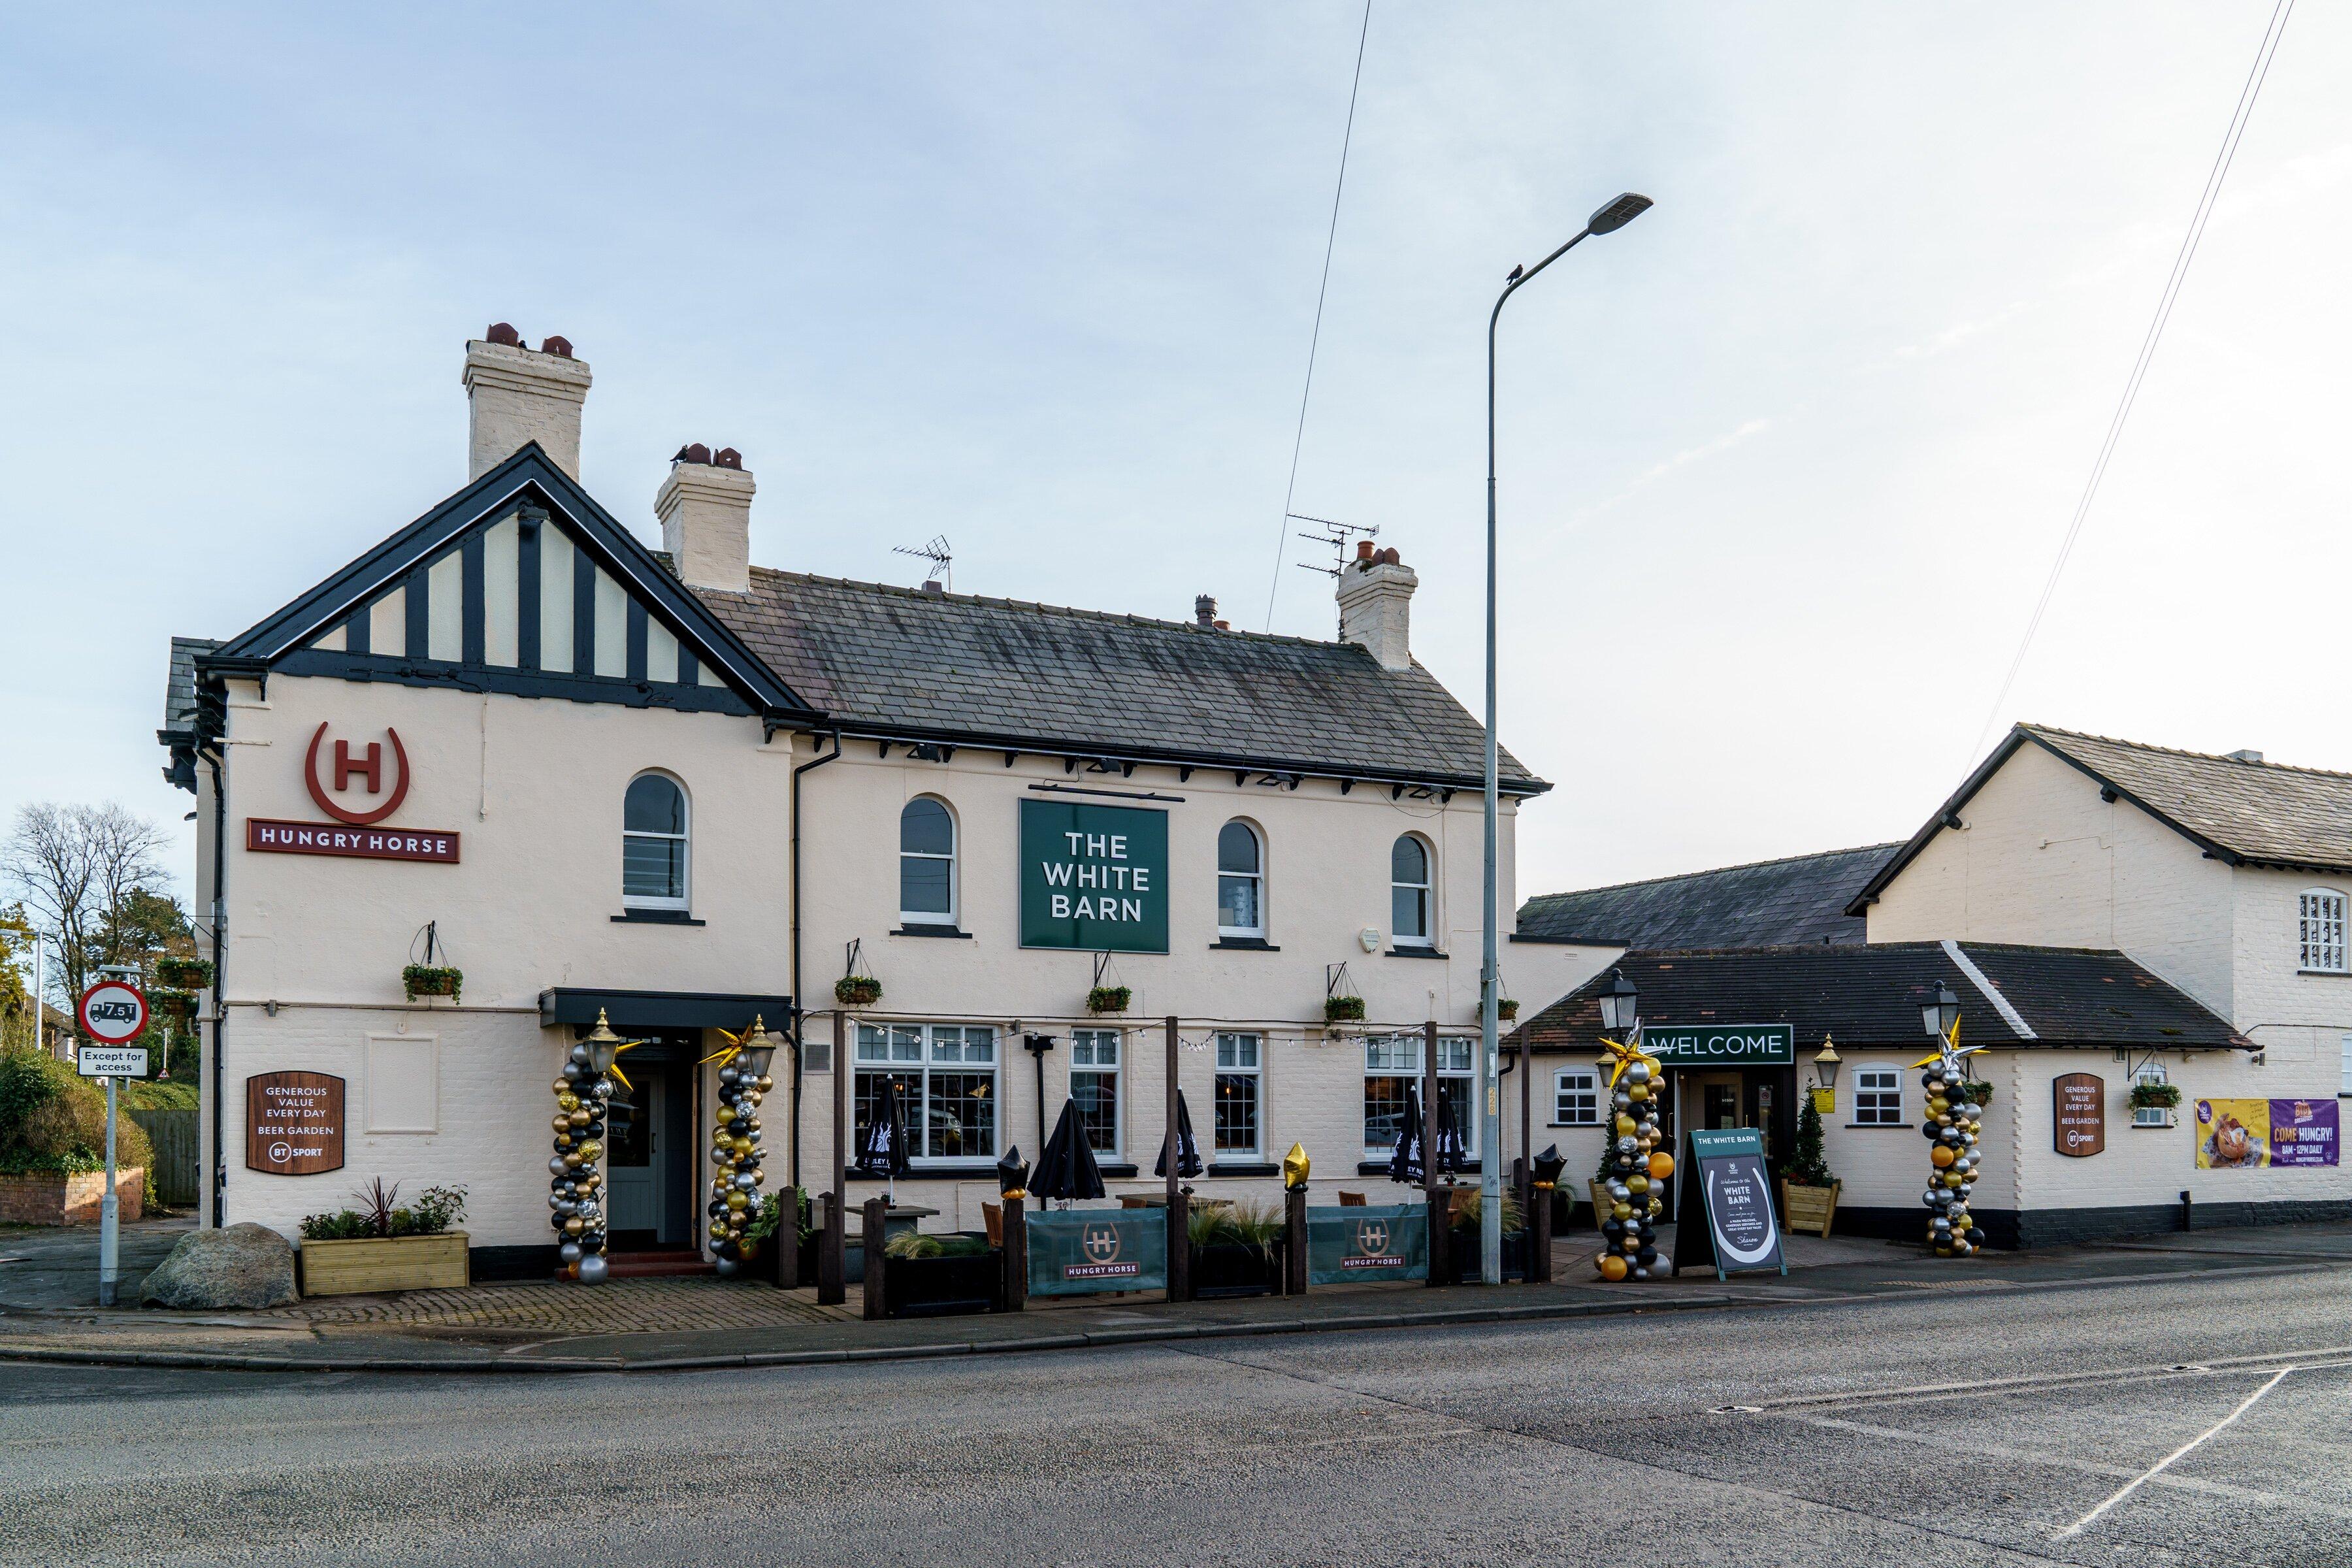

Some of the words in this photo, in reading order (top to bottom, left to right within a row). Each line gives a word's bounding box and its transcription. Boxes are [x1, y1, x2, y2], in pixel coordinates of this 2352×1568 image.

[261, 828, 361, 847] HUNGRY
[370, 836, 446, 853] HORSE
[1065, 832, 1127, 858] THE
[1042, 862, 1149, 891] WHITE
[1051, 894, 1141, 922] BARN
[1651, 1035, 1783, 1055] WELCOME
[85, 1051, 123, 1062] Except
[127, 1053, 142, 1061] for
[266, 1087, 327, 1096] GENEROUS
[278, 1098, 314, 1107] VALUE
[2294, 1115, 2313, 1124] BREAKFAST
[2274, 1128, 2297, 1142] COME
[2298, 1127, 2333, 1142] HUNGRY!
[274, 1148, 287, 1156] BT
[293, 1148, 323, 1156] SPORT
[2282, 1145, 2293, 1154] 8AM
[2296, 1145, 2309, 1154] 12PM
[2309, 1145, 2323, 1154] DAILY
[1723, 1186, 1751, 1195] WHITE
[1727, 1195, 1751, 1205] BARN
